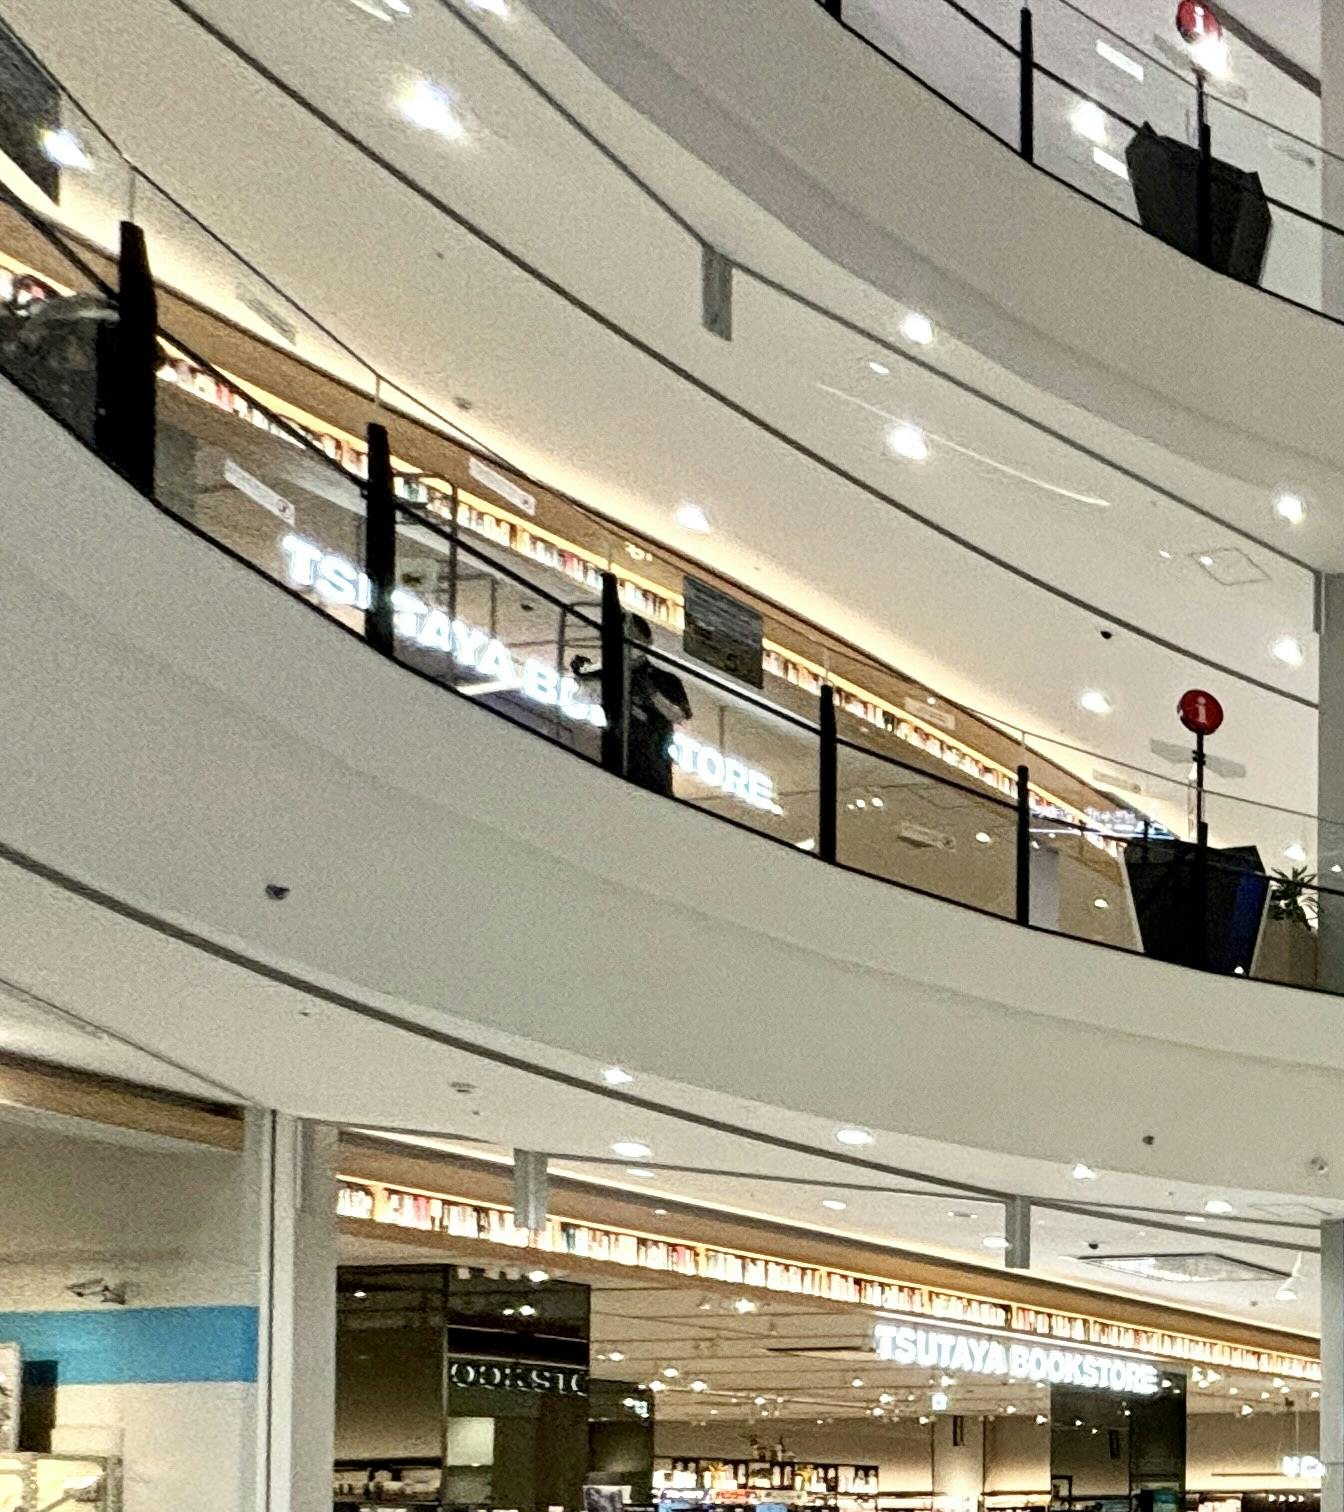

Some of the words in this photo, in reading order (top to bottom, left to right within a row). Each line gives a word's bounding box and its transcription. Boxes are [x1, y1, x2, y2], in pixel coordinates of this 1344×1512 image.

[281, 534, 515, 683] TSTAYA
[873, 1323, 1008, 1376] TSUTAYA
[1008, 1343, 1160, 1396] BOOKSTORE
